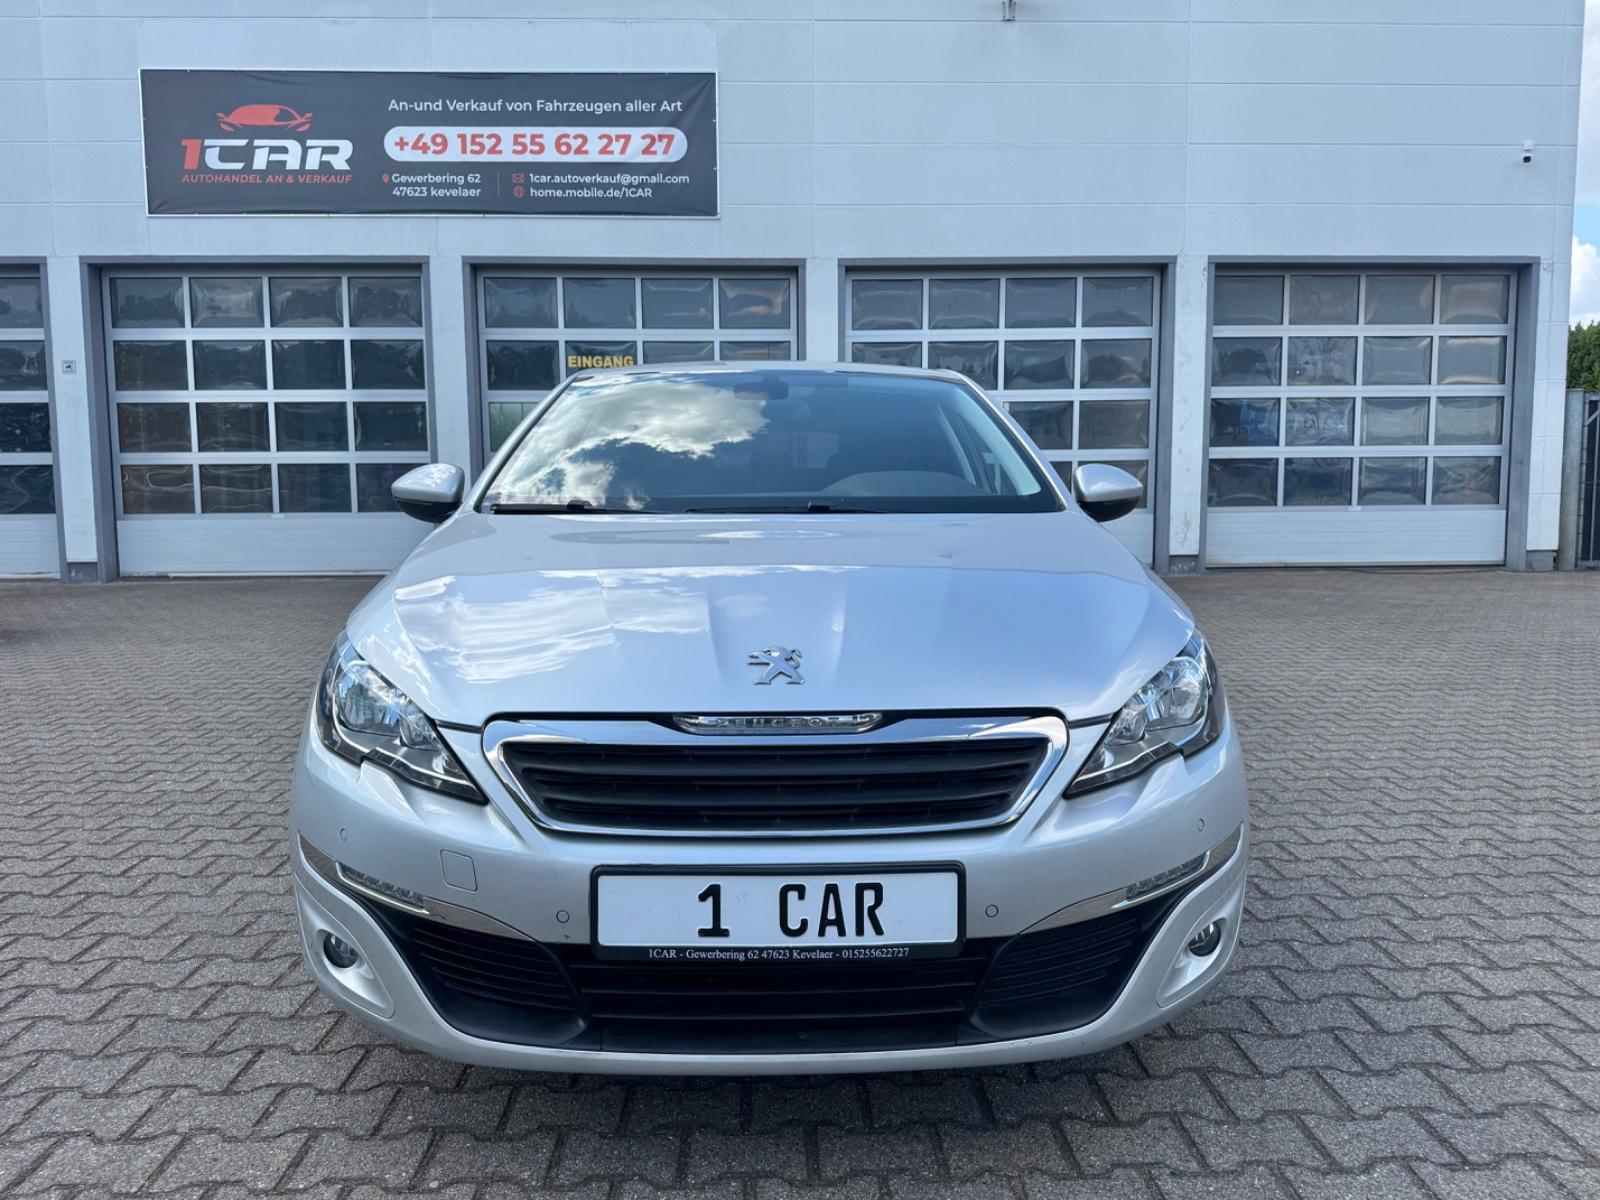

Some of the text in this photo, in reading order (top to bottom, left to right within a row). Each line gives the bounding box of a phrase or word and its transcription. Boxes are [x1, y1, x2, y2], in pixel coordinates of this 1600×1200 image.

[388, 99, 683, 115] An-und Verkauf von Fahrzeugen aller Art
[394, 133, 675, 156] +49 152 55 62 27 27
[181, 139, 353, 170] 1CAR
[182, 174, 353, 184] AUTOHANDEL AN & VERKAUF
[392, 173, 481, 185] Gewerbering 62
[529, 173, 690, 185] 1car.autoverkauf@gmail.com
[392, 186, 481, 197] 47623 kevelaer
[530, 187, 653, 198] home.mobile.de/1CAR
[568, 355, 634, 368] EINGANG
[716, 716, 841, 728] PEUGEOT
[698, 882, 885, 937] 1 CAR
[686, 949, 746, 962] Gewerbering
[747, 950, 759, 959] 62
[761, 949, 790, 959] 47623
[792, 949, 834, 959] Kevelaer
[842, 947, 909, 959] 015255622727
